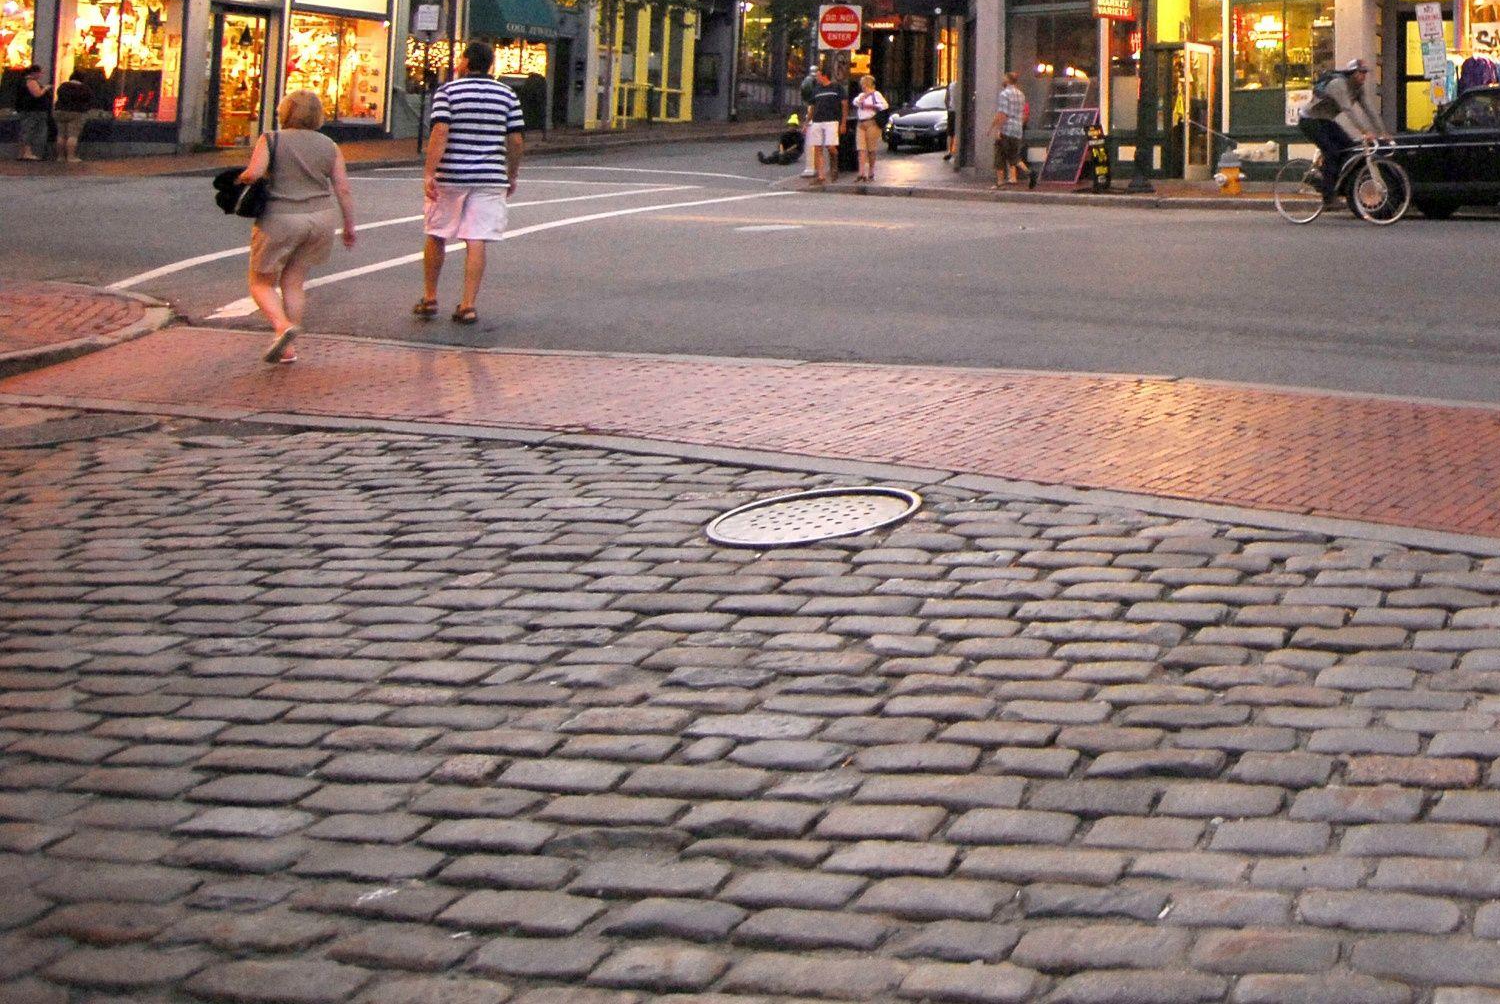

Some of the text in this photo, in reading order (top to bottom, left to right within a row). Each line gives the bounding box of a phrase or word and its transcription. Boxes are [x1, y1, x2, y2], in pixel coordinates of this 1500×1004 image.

[1098, 6, 1129, 16] VARIETY
[825, 14, 854, 23] DO NOT
[827, 33, 851, 41] ENTER
